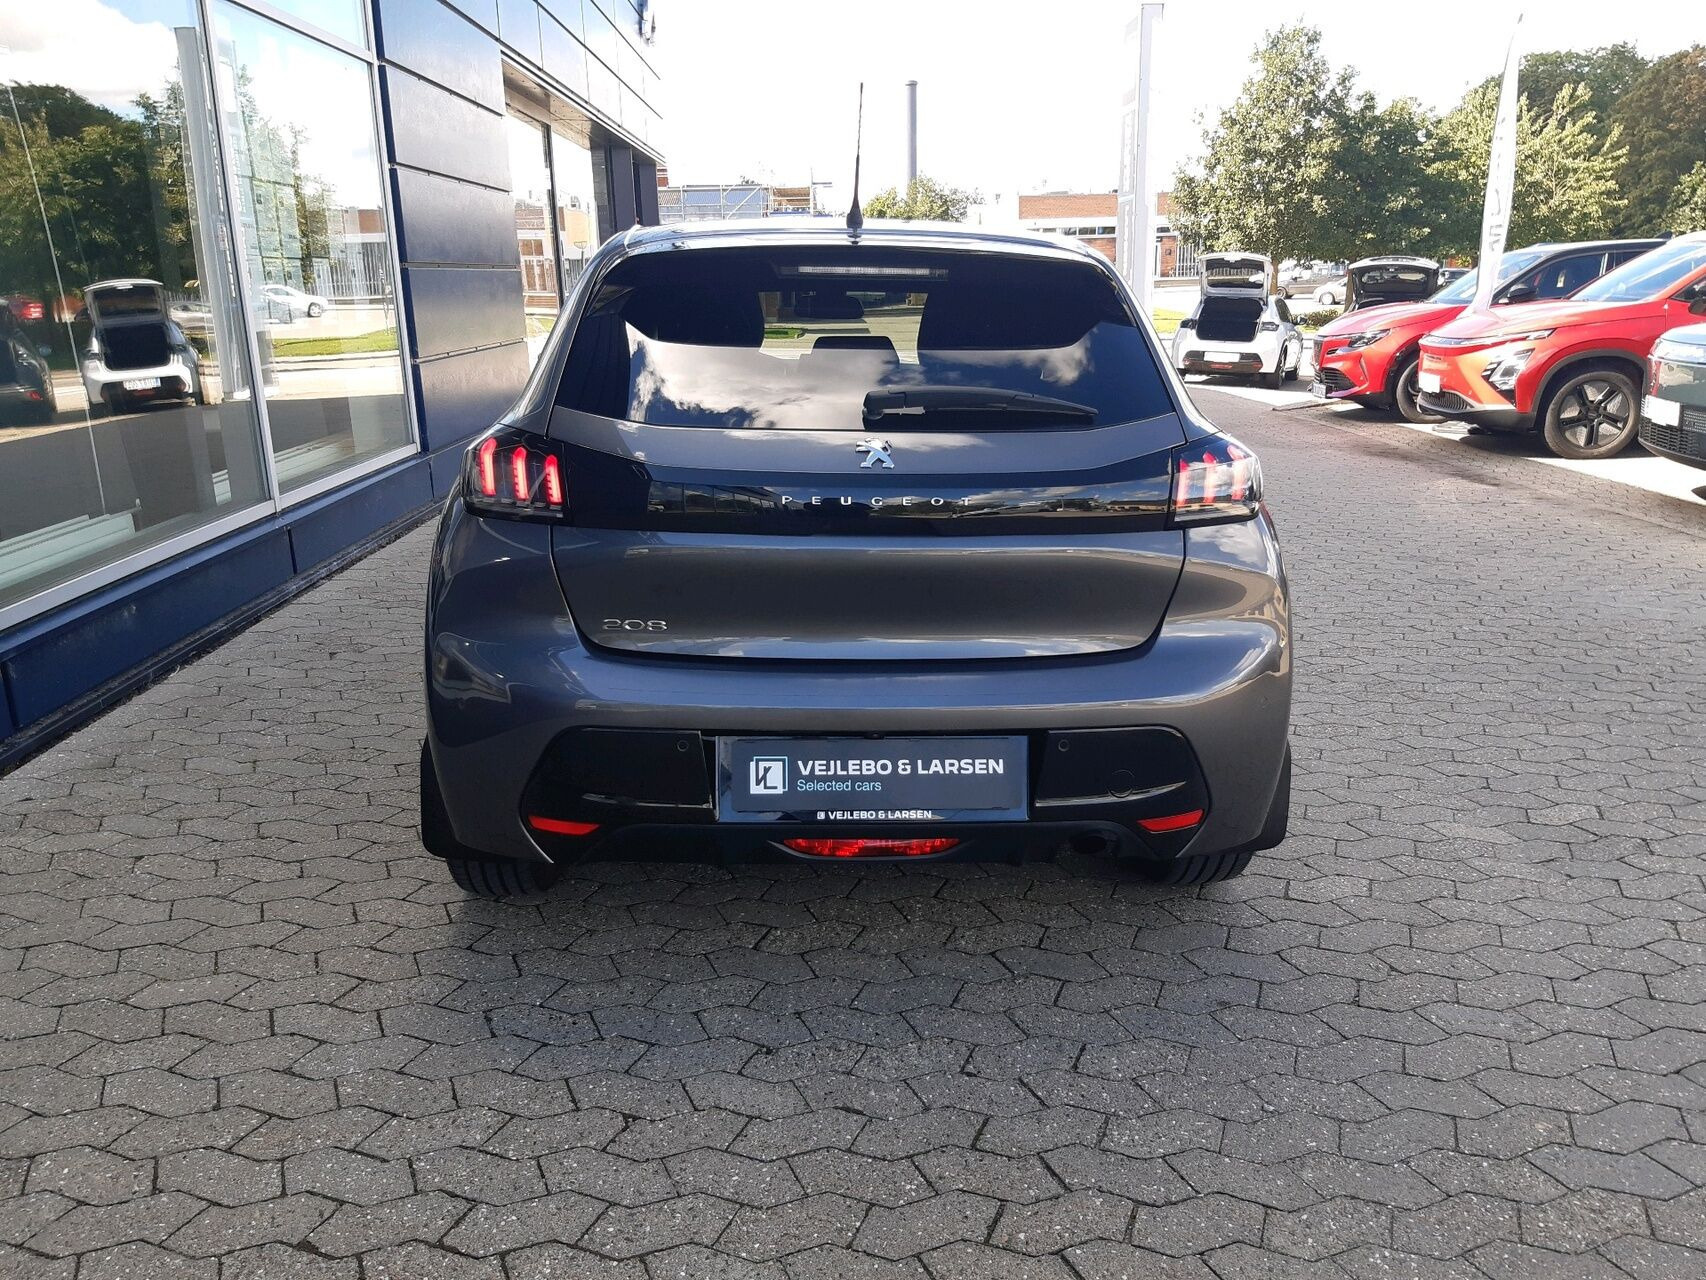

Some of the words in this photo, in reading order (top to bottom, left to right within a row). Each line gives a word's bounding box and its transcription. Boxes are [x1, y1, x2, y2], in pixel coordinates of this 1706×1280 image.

[781, 495, 972, 506] PEUGEOT
[602, 618, 668, 631] 208
[797, 759, 892, 776] VEJLEBO
[897, 759, 911, 775] &
[917, 758, 1004, 775] LARSEN
[797, 779, 852, 792] Selected
[854, 781, 882, 792] cars
[828, 810, 876, 820] VEJLEBO
[877, 810, 885, 819] &
[887, 810, 932, 820] LARSEN
